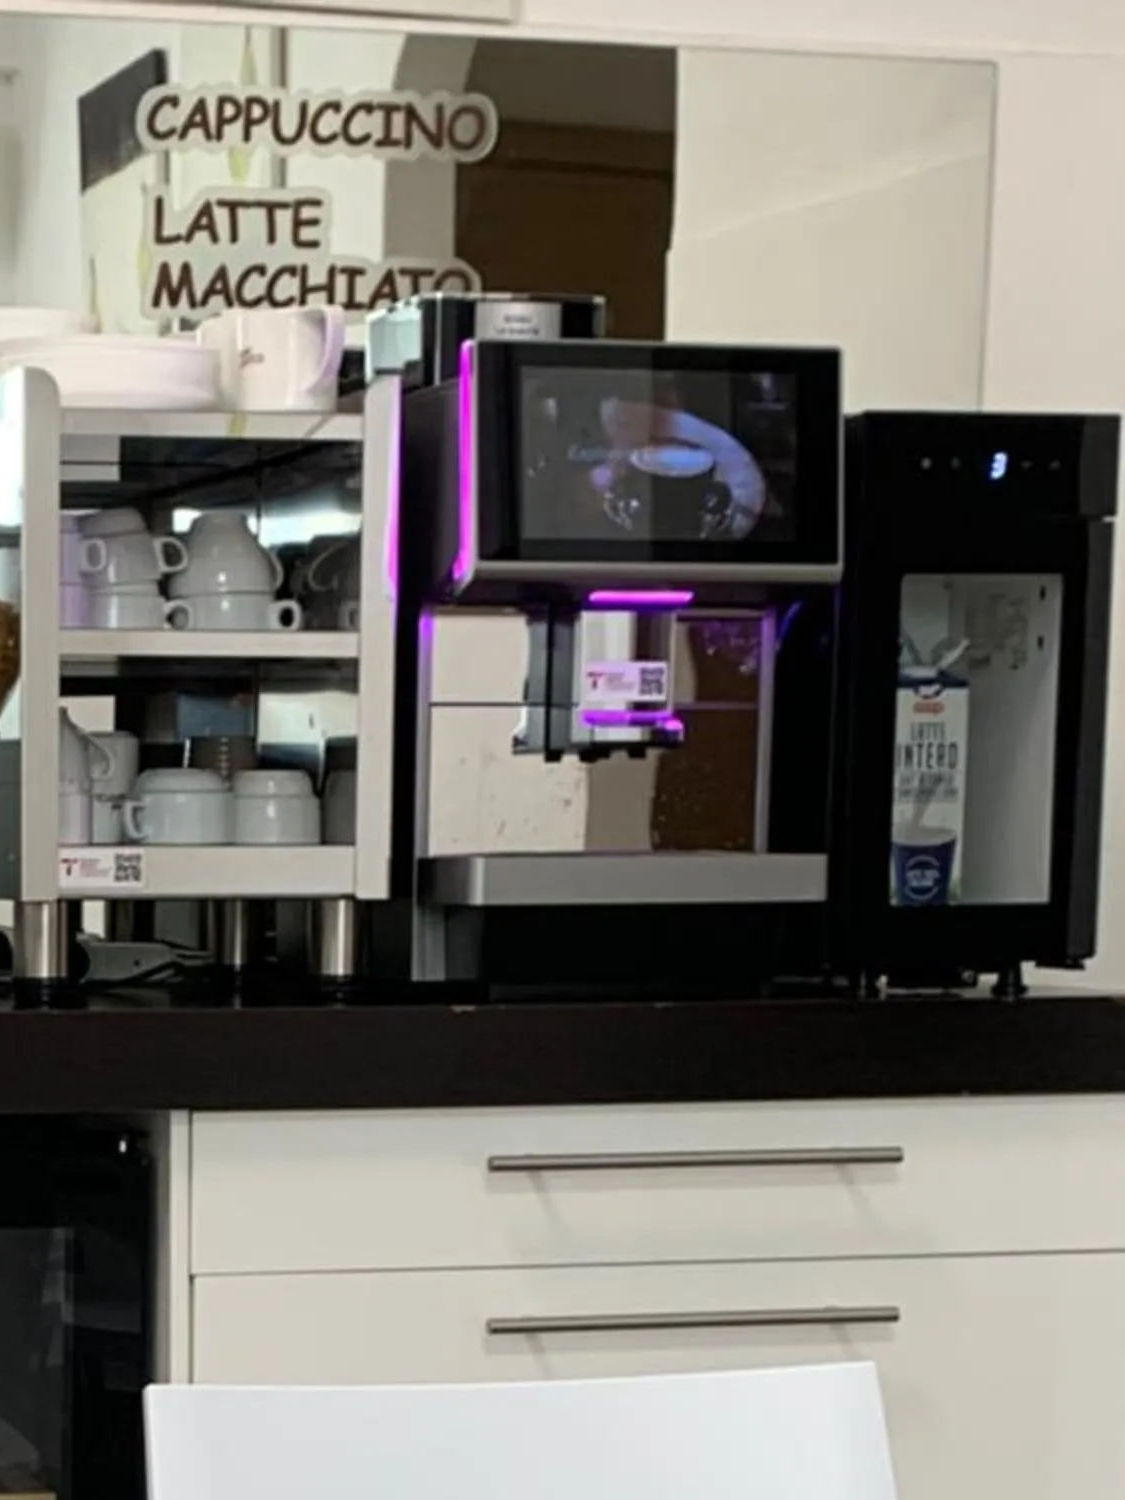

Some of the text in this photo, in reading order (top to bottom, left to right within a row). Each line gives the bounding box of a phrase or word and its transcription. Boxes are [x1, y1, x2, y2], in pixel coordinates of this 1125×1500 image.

[146, 95, 487, 151] CAPPUCCINO
[153, 195, 324, 248] LATTE
[911, 721, 946, 741] LATTE
[896, 741, 958, 770] INTERO
